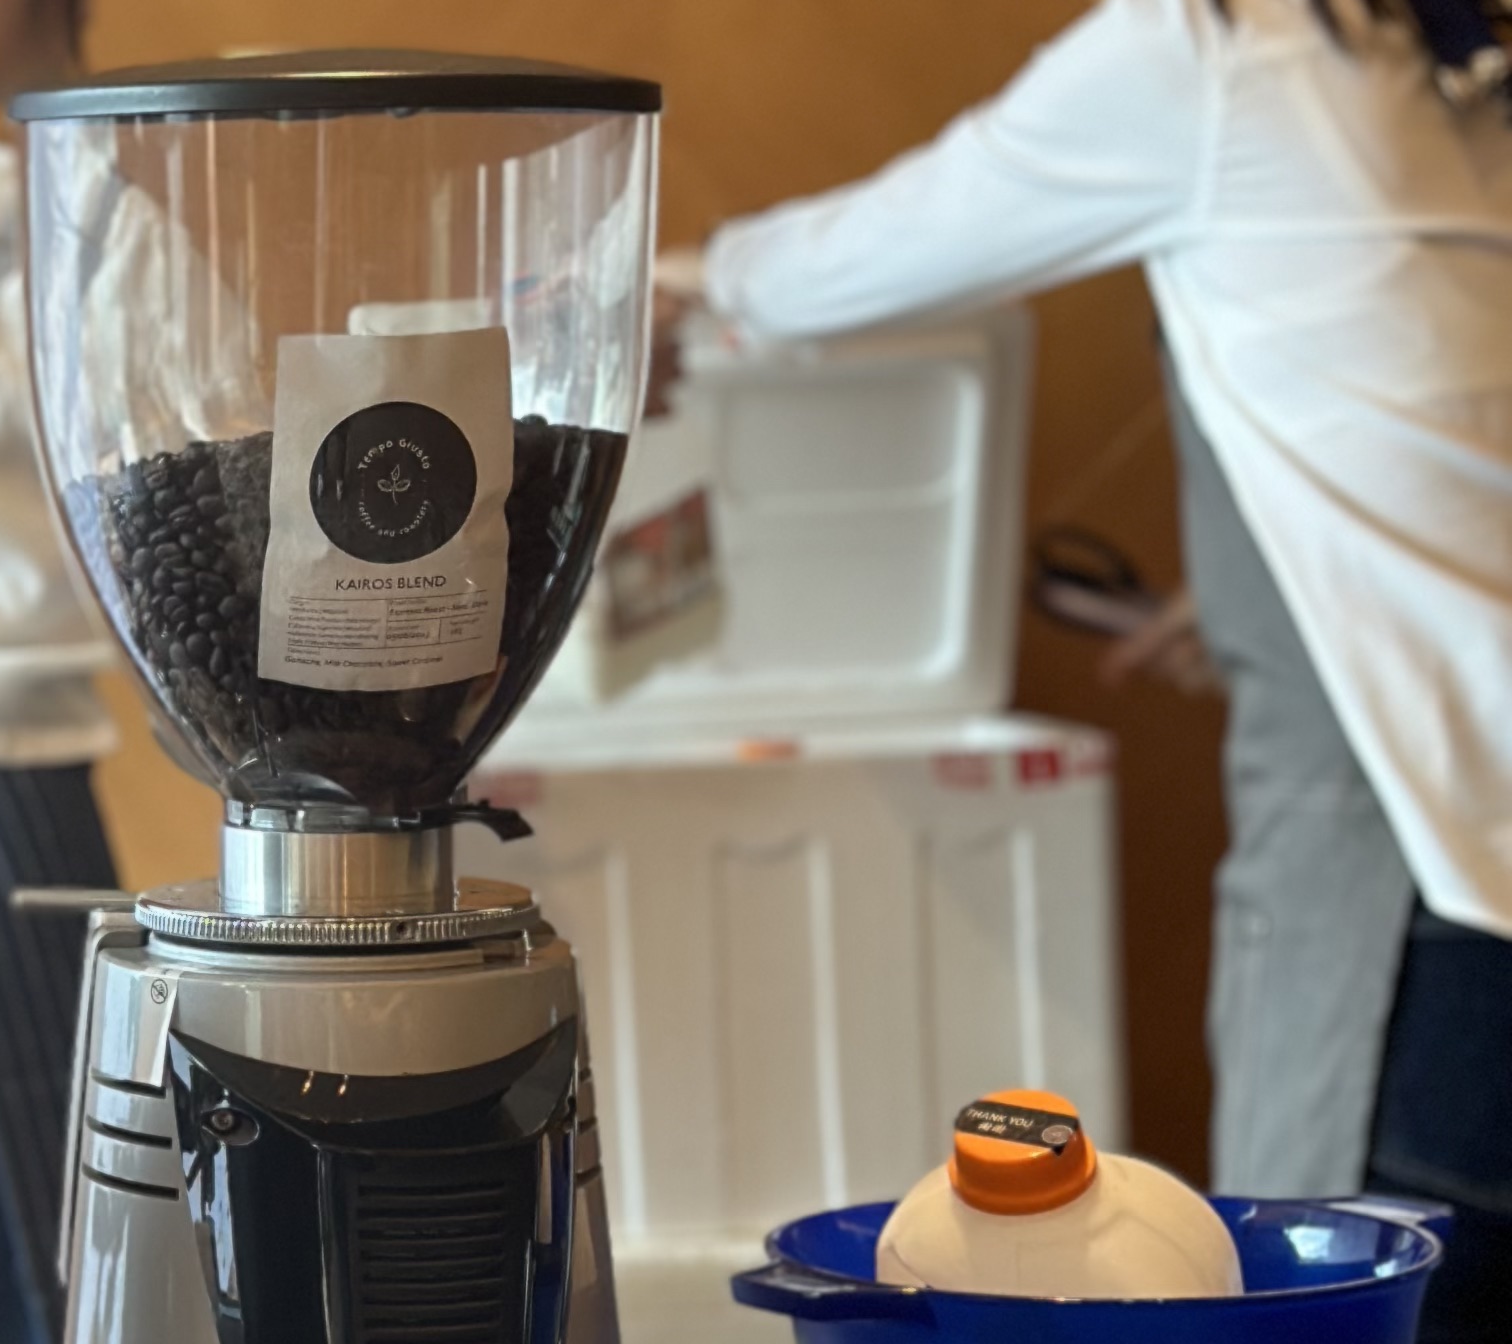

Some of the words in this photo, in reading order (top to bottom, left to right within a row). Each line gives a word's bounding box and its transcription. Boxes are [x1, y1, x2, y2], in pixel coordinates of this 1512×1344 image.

[377, 528, 395, 537] and
[335, 577, 393, 591] KAIROS
[397, 575, 447, 589] BLEND
[967, 1109, 1007, 1122] THANK
[1009, 1116, 1034, 1127] YOU
